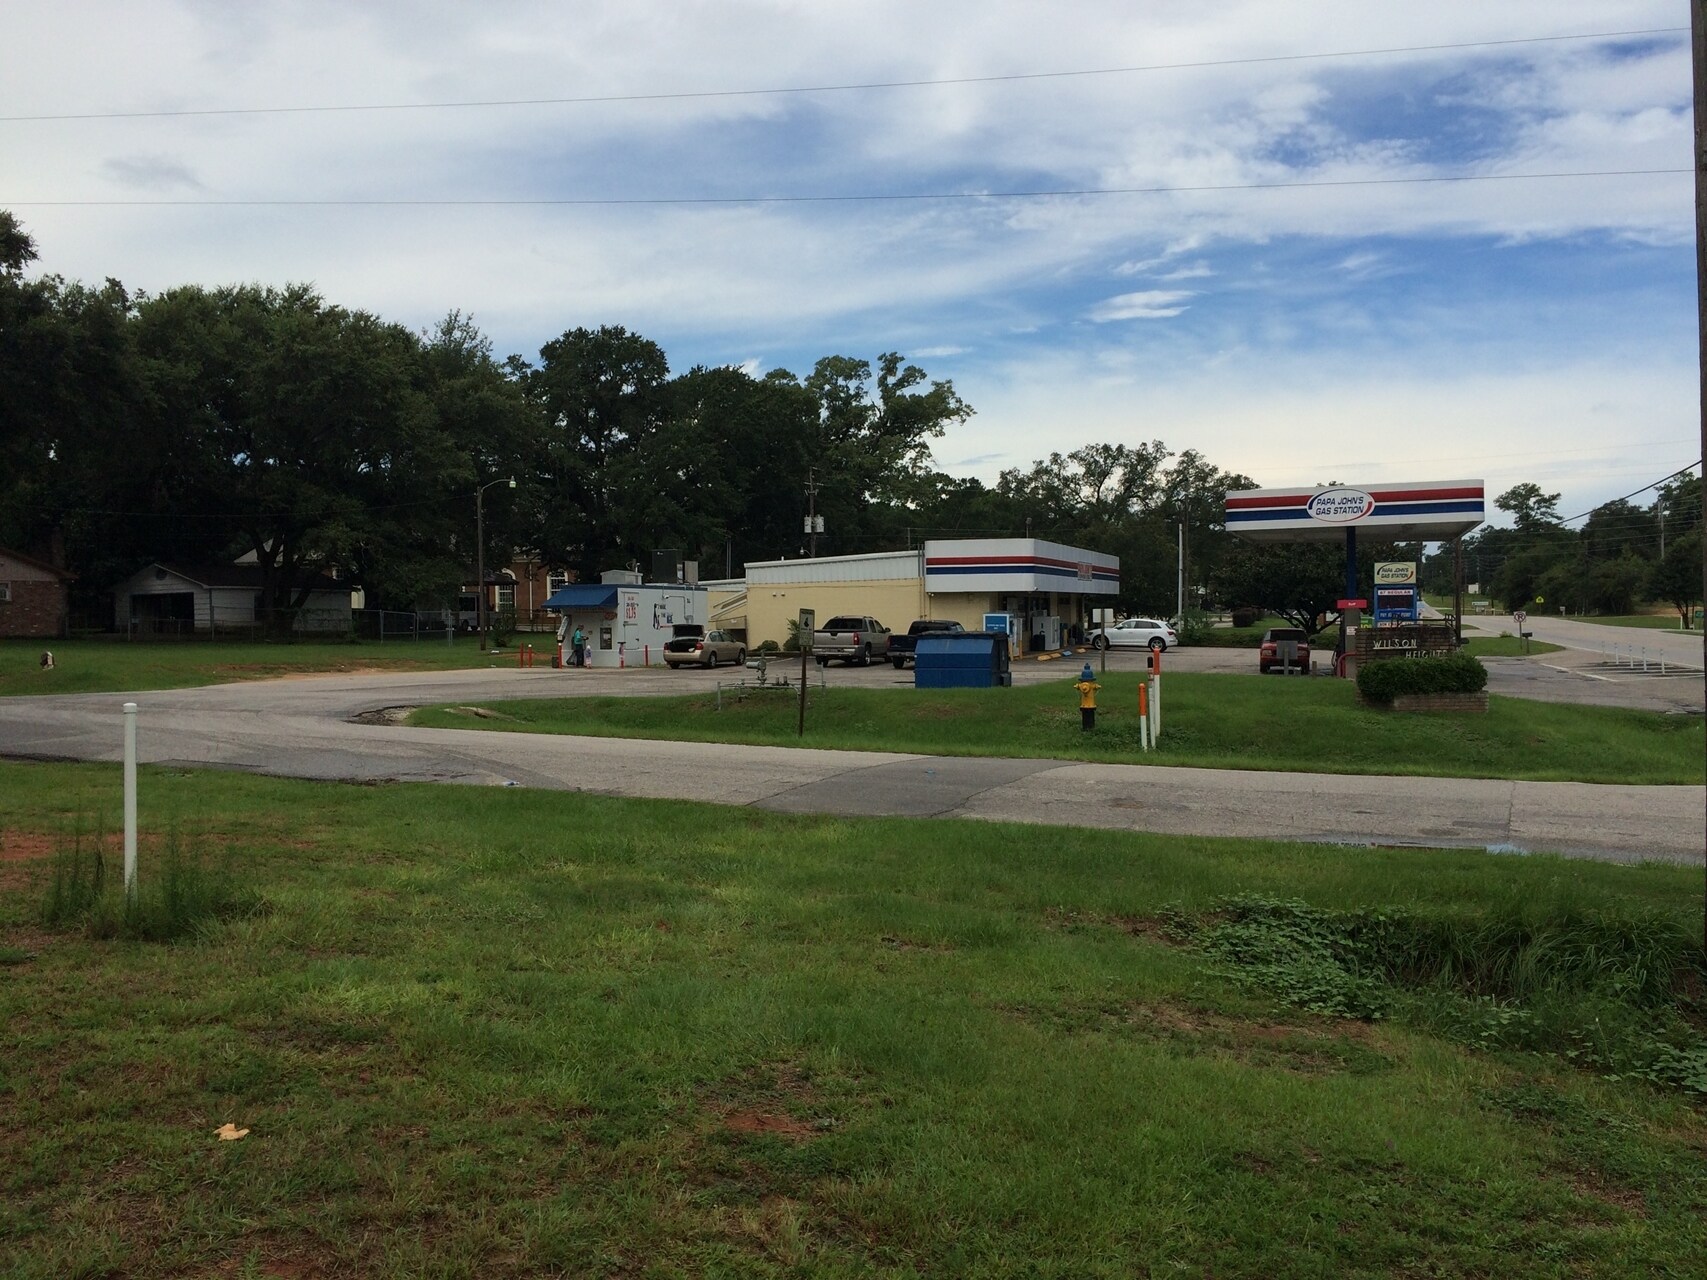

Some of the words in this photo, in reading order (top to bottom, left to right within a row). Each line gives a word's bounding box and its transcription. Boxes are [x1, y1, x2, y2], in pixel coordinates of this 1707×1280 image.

[1316, 498, 1336, 506] PAPA
[1338, 496, 1364, 506] JOHN'S
[1333, 506, 1364, 514] STATION
[1373, 639, 1417, 648] WILSON
